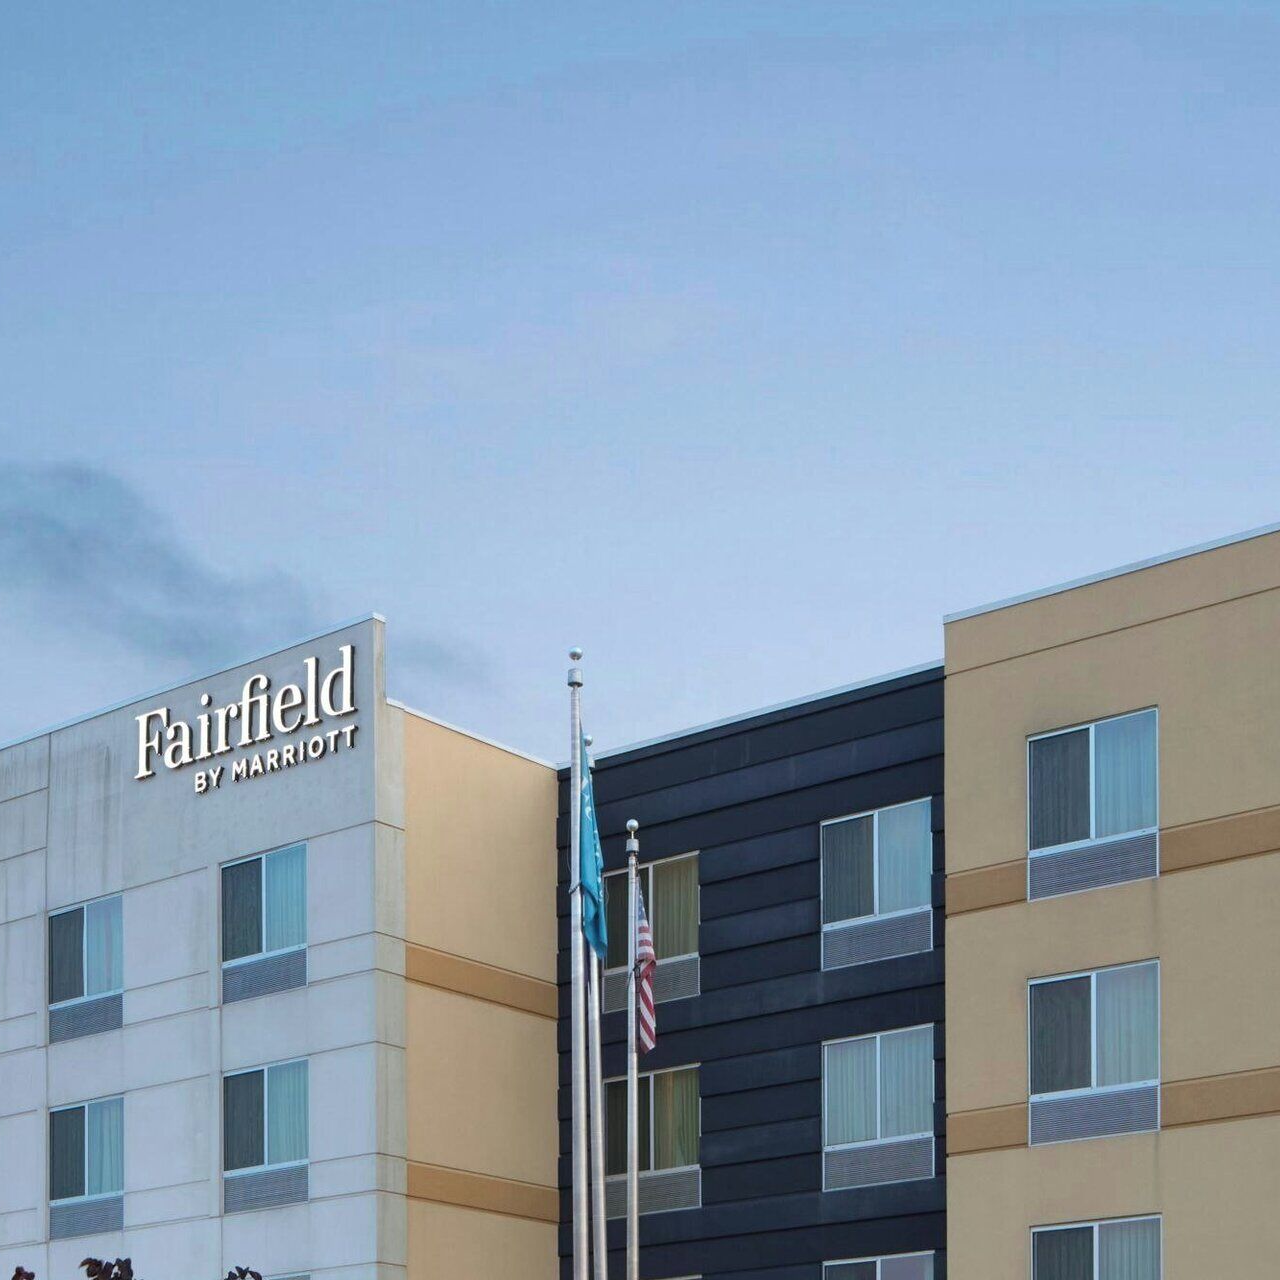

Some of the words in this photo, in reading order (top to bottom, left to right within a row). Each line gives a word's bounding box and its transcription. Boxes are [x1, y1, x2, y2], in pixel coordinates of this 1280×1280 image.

[134, 645, 357, 779] Fairfield
[195, 766, 224, 793] BY
[231, 724, 358, 782] MARRIOTT
